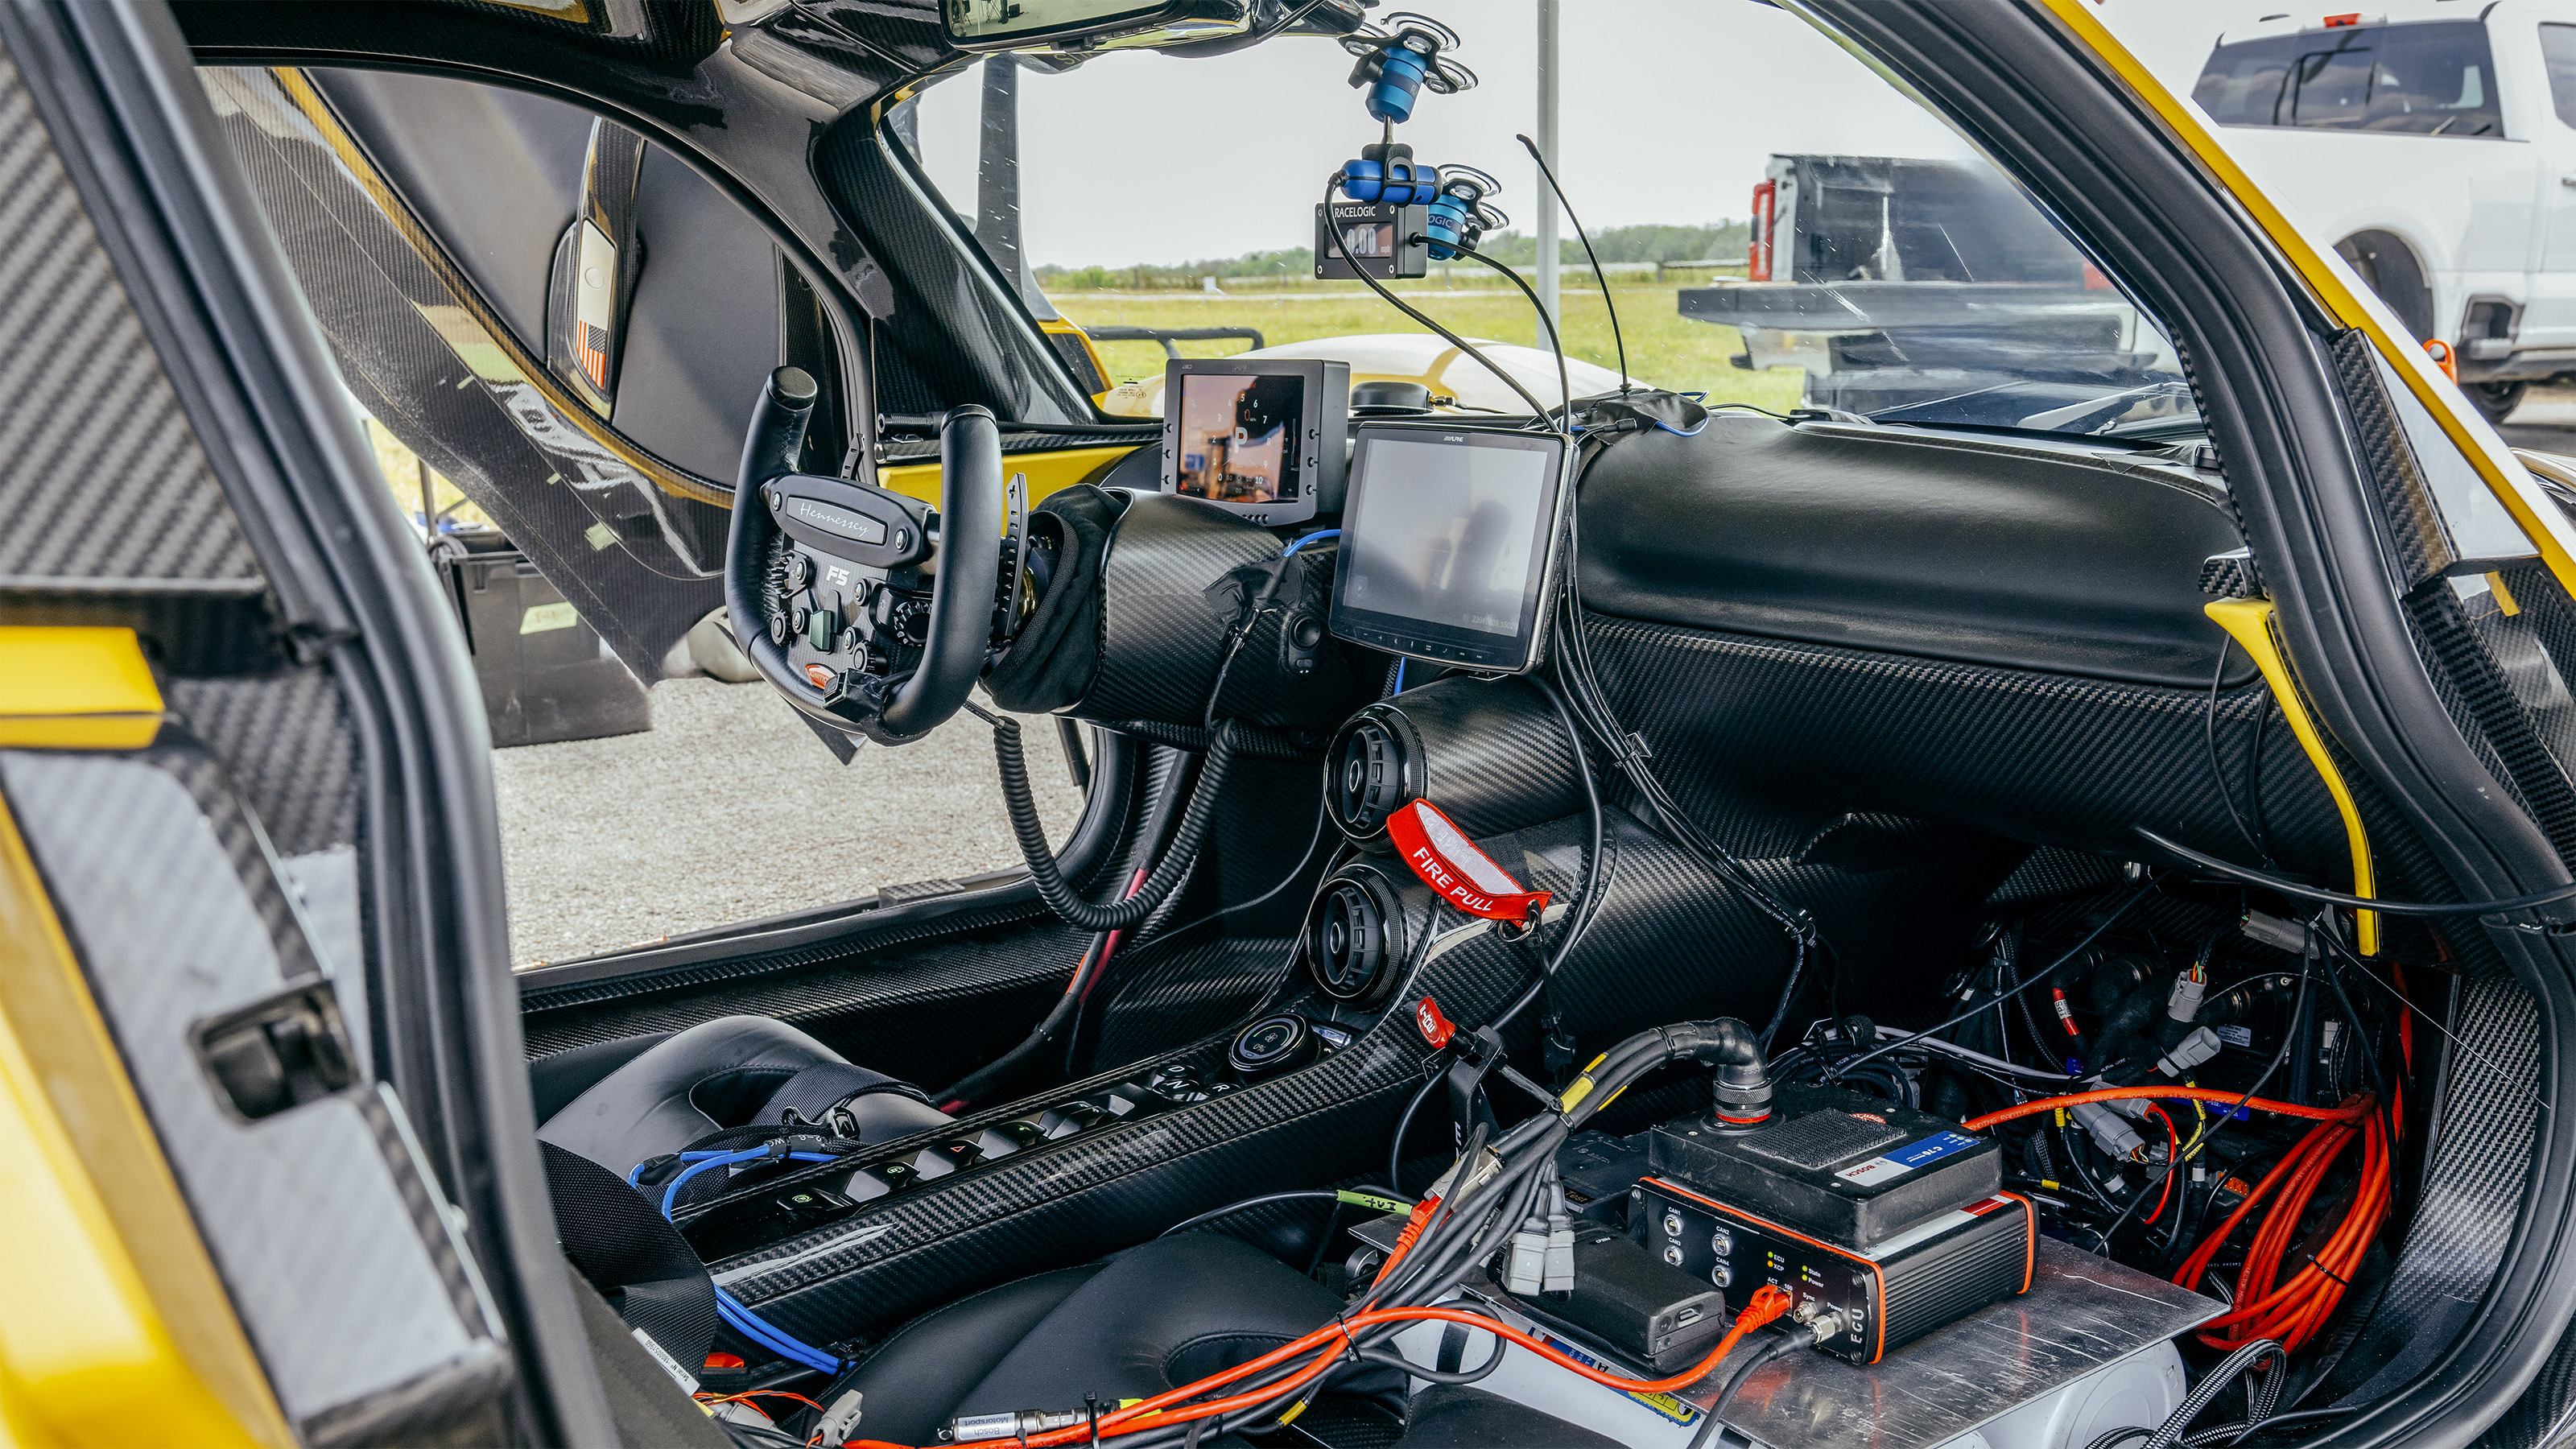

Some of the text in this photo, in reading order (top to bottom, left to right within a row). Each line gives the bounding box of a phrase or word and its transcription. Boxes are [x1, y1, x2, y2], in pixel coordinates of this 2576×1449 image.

[1335, 206, 1376, 217] RACELOGIC
[1347, 228, 1377, 254] 0.00
[1241, 394, 1245, 402] 5
[1253, 400, 1257, 408] 6
[1218, 414, 1222, 422] 3
[1263, 415, 1268, 423] 7
[1212, 435, 1216, 443] 2
[1234, 427, 1249, 453] P
[1213, 458, 1216, 466] 1
[1264, 460, 1268, 469] 9
[1218, 473, 1222, 481] 0
[1255, 476, 1263, 484] 10
[800, 502, 869, 537] Hennessey
[826, 565, 850, 586] F5
[1413, 847, 1493, 911] FIRE PULL
[1419, 1004, 1435, 1034] FIRE
[1166, 1080, 1190, 1089] N
[1212, 1084, 1230, 1092] R
[1845, 1164, 1876, 1178] BOSCH
[1565, 1190, 1587, 1202] Test
[1668, 1207, 1681, 1216] CAN1
[1715, 1225, 1730, 1235] CAN2
[1668, 1237, 1681, 1246] CAN3
[1715, 1257, 1729, 1265] CAN4
[1773, 1254, 1785, 1263] ECU
[1808, 1268, 1822, 1278] State
[1767, 1277, 1778, 1285] ACT
[1808, 1278, 1824, 1288] Power
[1802, 1292, 1815, 1302] Sync
[1827, 1302, 1843, 1312] Power
[1850, 1308, 1864, 1344] ECU
[676, 1368, 689, 1381] Serial
[964, 1416, 1009, 1426] Motorsport
[974, 1427, 1000, 1435] Bosch
